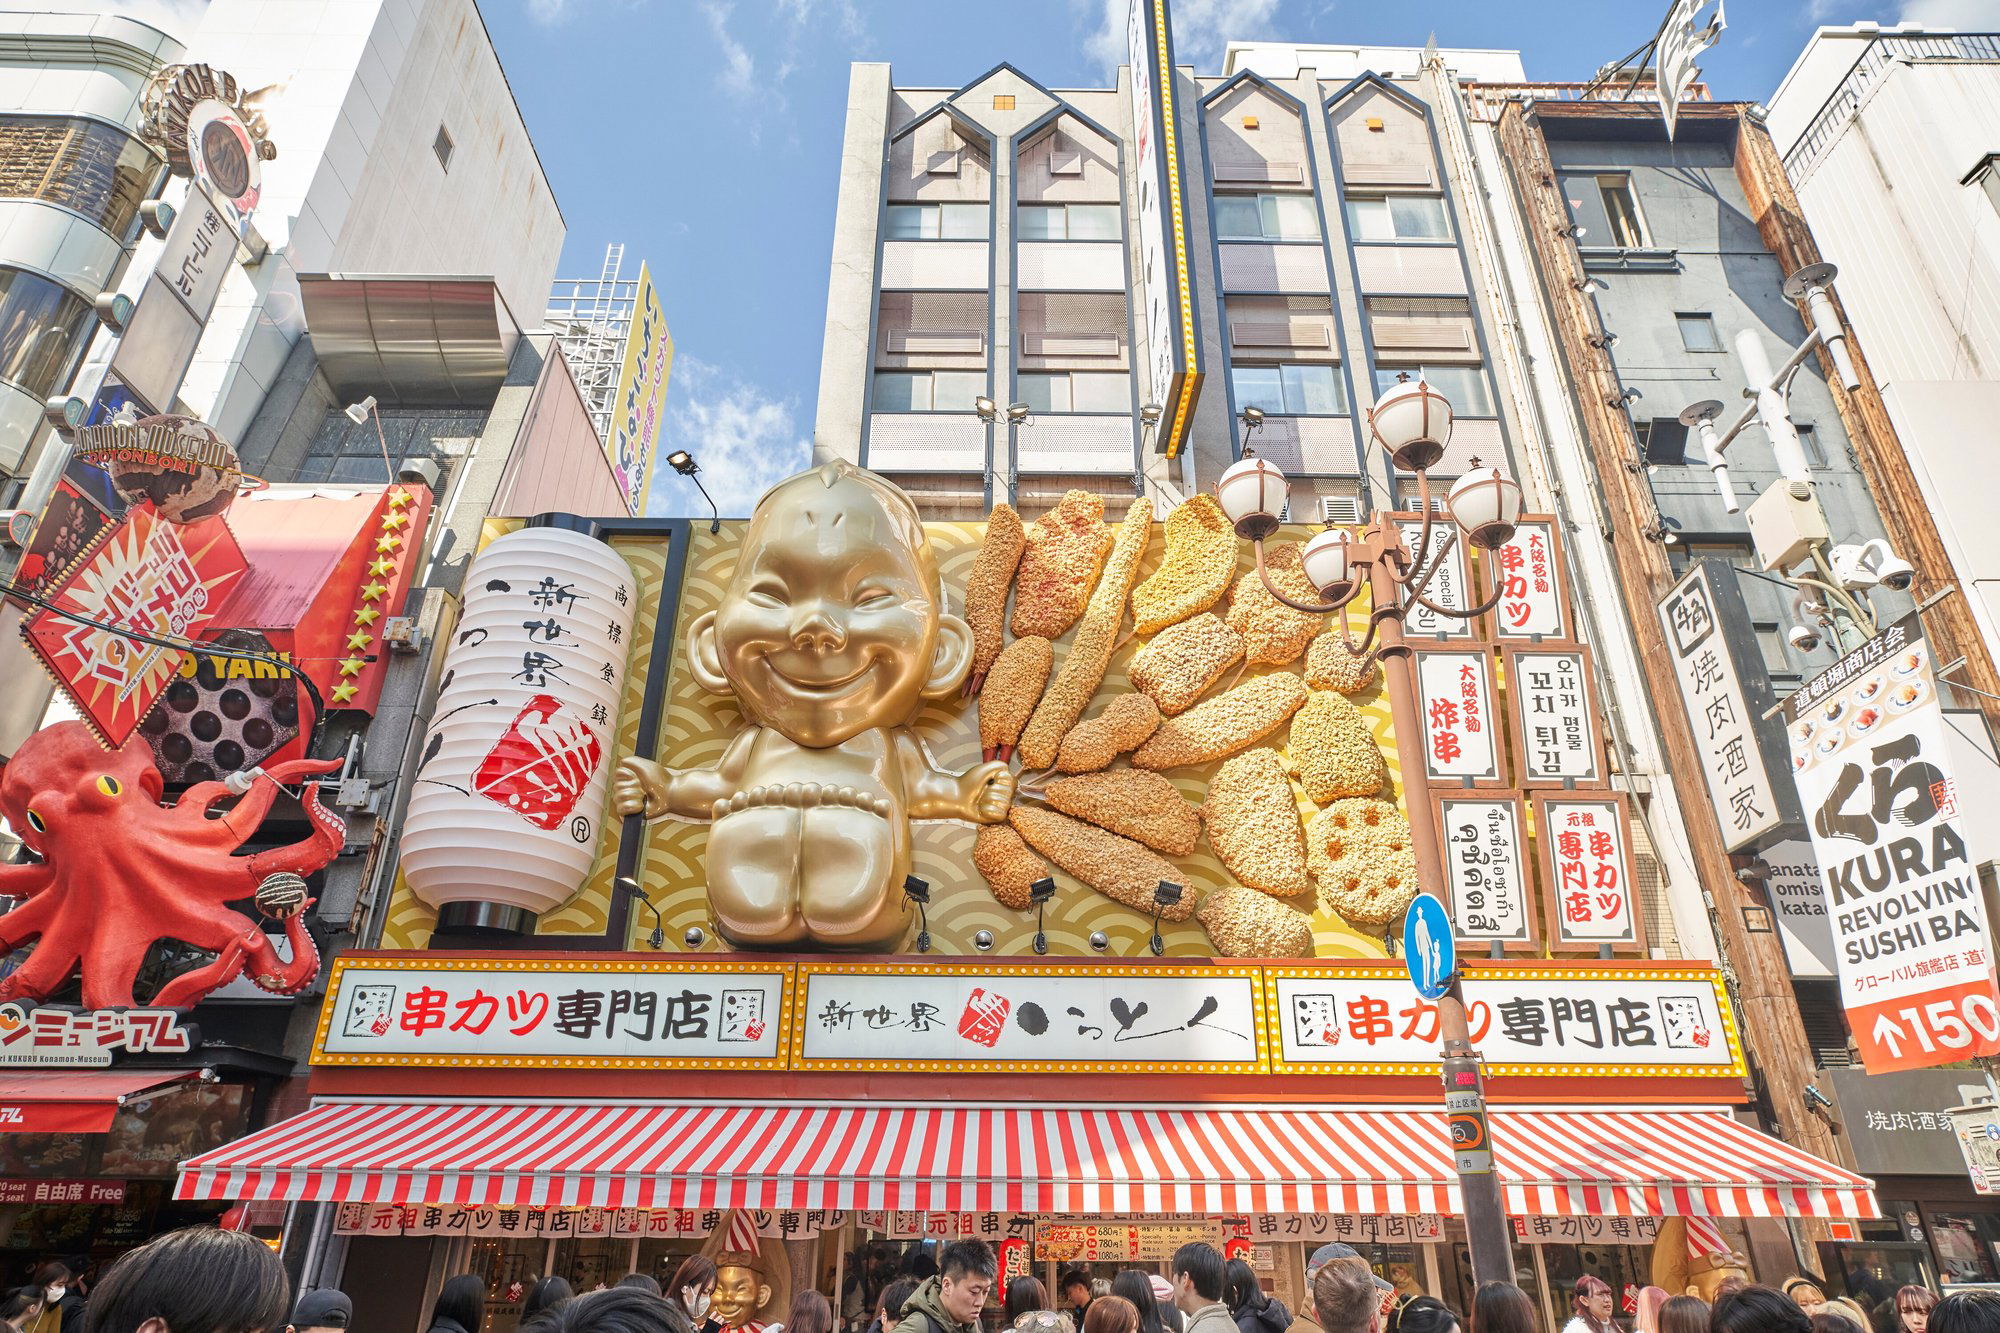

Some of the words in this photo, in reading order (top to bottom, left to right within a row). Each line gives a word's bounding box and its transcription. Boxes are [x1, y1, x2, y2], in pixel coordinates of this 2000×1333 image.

[89, 449, 196, 475] DOTONBORI
[147, 424, 228, 467] MUSEUM
[1500, 544, 1532, 628] 串カツ
[1529, 533, 1550, 593] 大阪名物
[511, 576, 590, 688] 新世界
[591, 584, 629, 726] 商標登録
[1528, 671, 1555, 714] 꼬치
[1556, 659, 1578, 708] 오사카
[1794, 625, 1906, 712] 道頓堀商店会
[1459, 664, 1481, 733] 大阪名物
[1429, 697, 1462, 764] 炸串
[1535, 725, 1562, 773] 튀김
[1563, 716, 1584, 751] 명물
[1689, 650, 1766, 831] 焼肉酒家
[1566, 811, 1596, 827] 元祖
[1588, 830, 1622, 921] 串カツ
[1827, 822, 1968, 907] KURA
[1845, 920, 1927, 965] SUSHI
[1928, 908, 1981, 943] BA
[1854, 953, 1960, 992] グローバル旗艦店
[1963, 947, 1987, 968] 道
[399, 984, 713, 1041] 串カツ専門店
[818, 999, 947, 1034] 新世界
[8, 1055, 38, 1063] KUKURU
[40, 1055, 109, 1063] Konamon-Museum
[1866, 1110, 1955, 1132] 焼肉酒家
[34, 1182, 84, 1201] 自由席
[90, 1184, 123, 1201] Free
[371, 1207, 572, 1232] 元祖串カツ専門店
[1098, 1226, 1118, 1236] 680円
[1098, 1239, 1119, 1248] 780円
